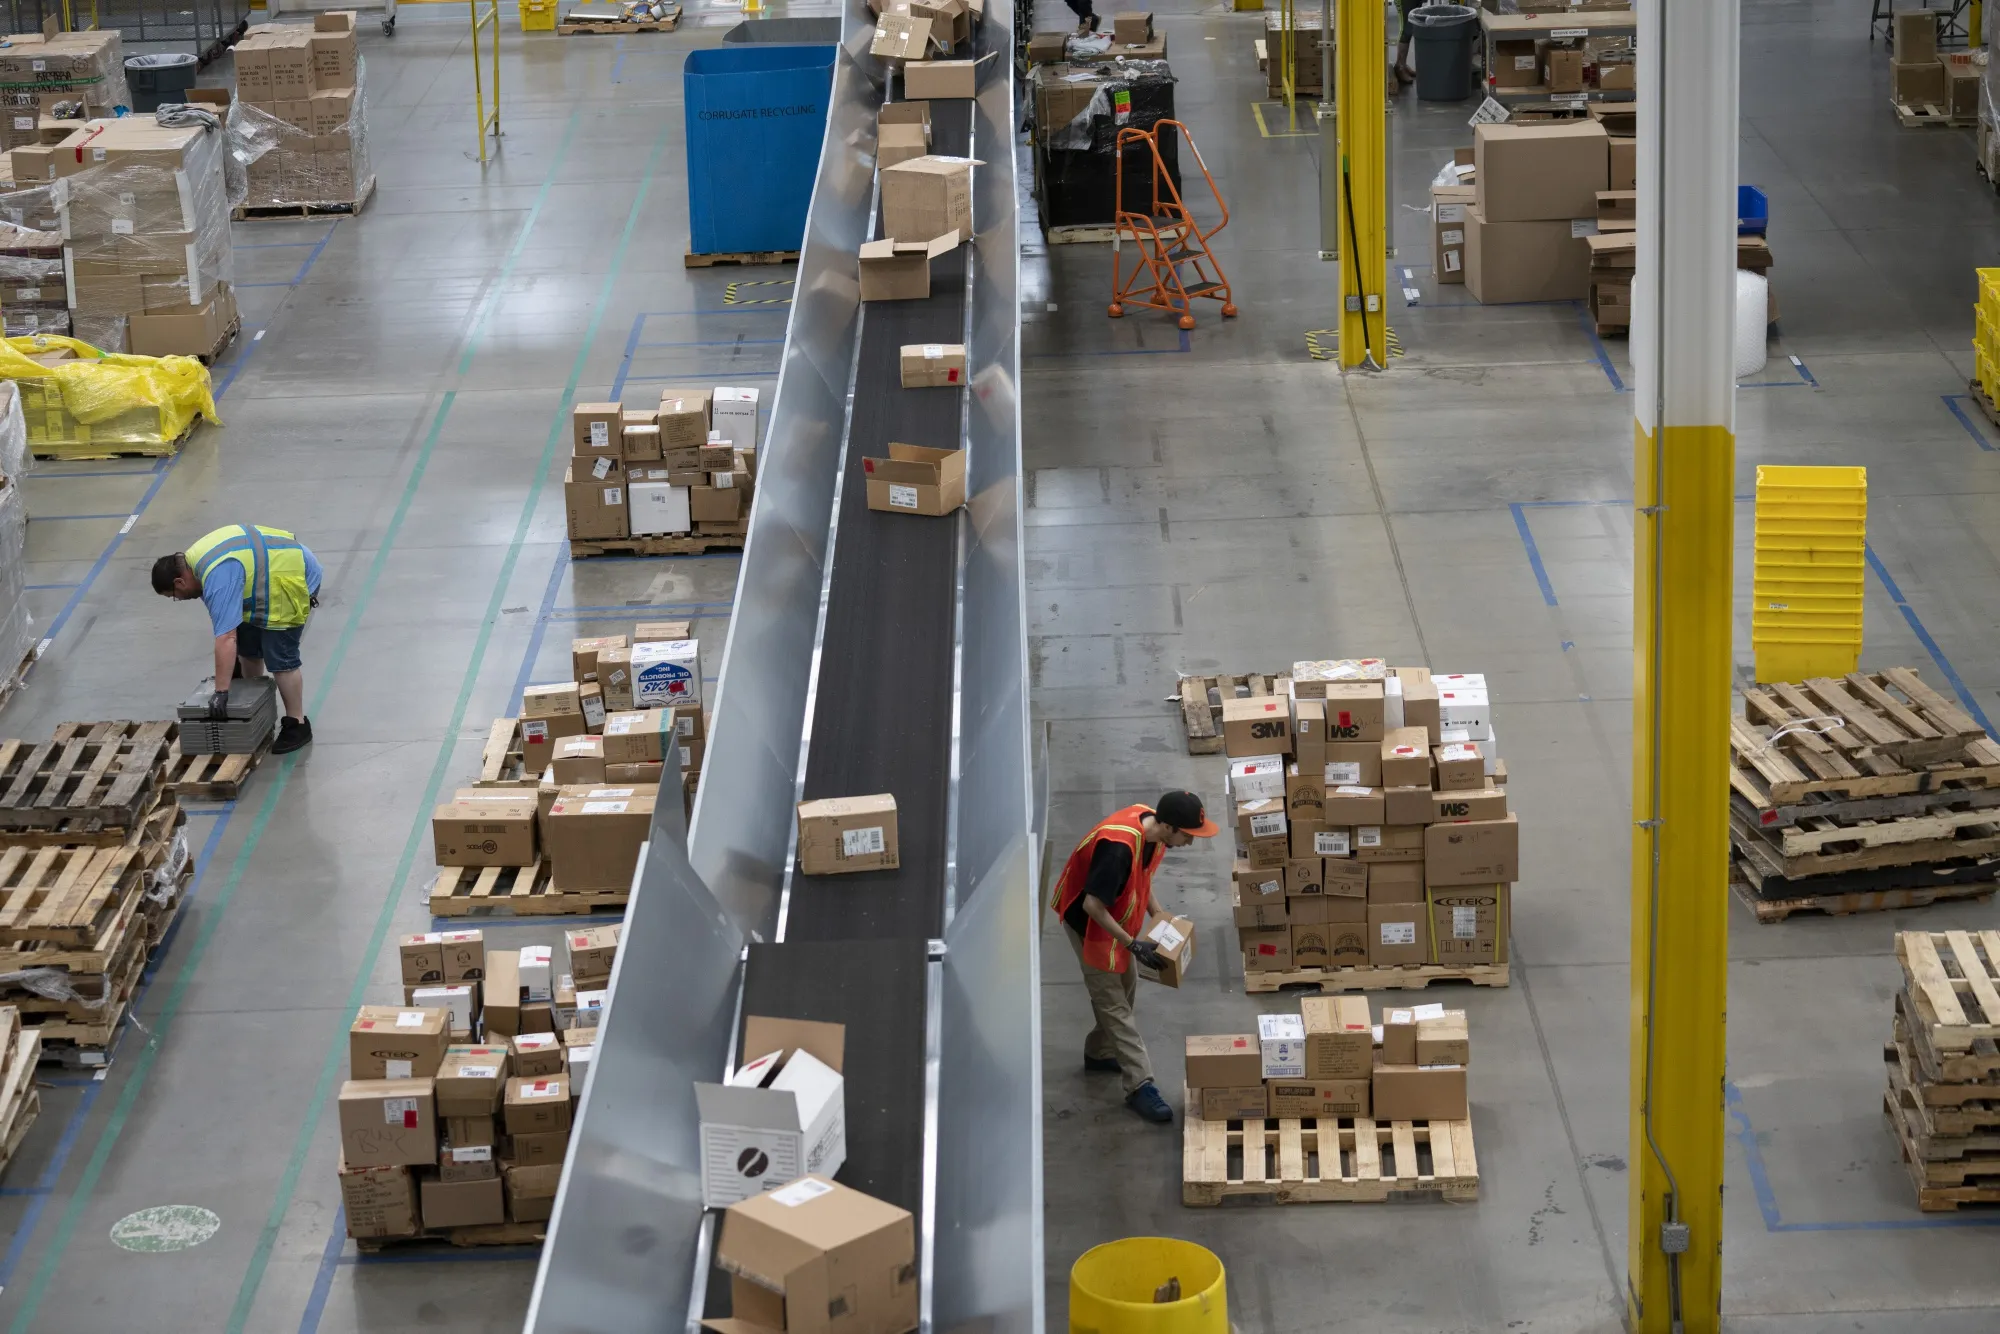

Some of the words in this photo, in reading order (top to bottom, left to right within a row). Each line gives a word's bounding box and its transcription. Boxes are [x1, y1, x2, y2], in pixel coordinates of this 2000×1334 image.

[698, 108, 758, 120] CORRUGATE
[760, 104, 816, 117] RECYCLING
[640, 672, 676, 680] PRODUCTS
[642, 680, 687, 692] CAS
[1251, 721, 1285, 739] 3M
[1331, 724, 1360, 739] 3M
[1441, 802, 1469, 816] 3M
[1444, 897, 1490, 906] CTEK
